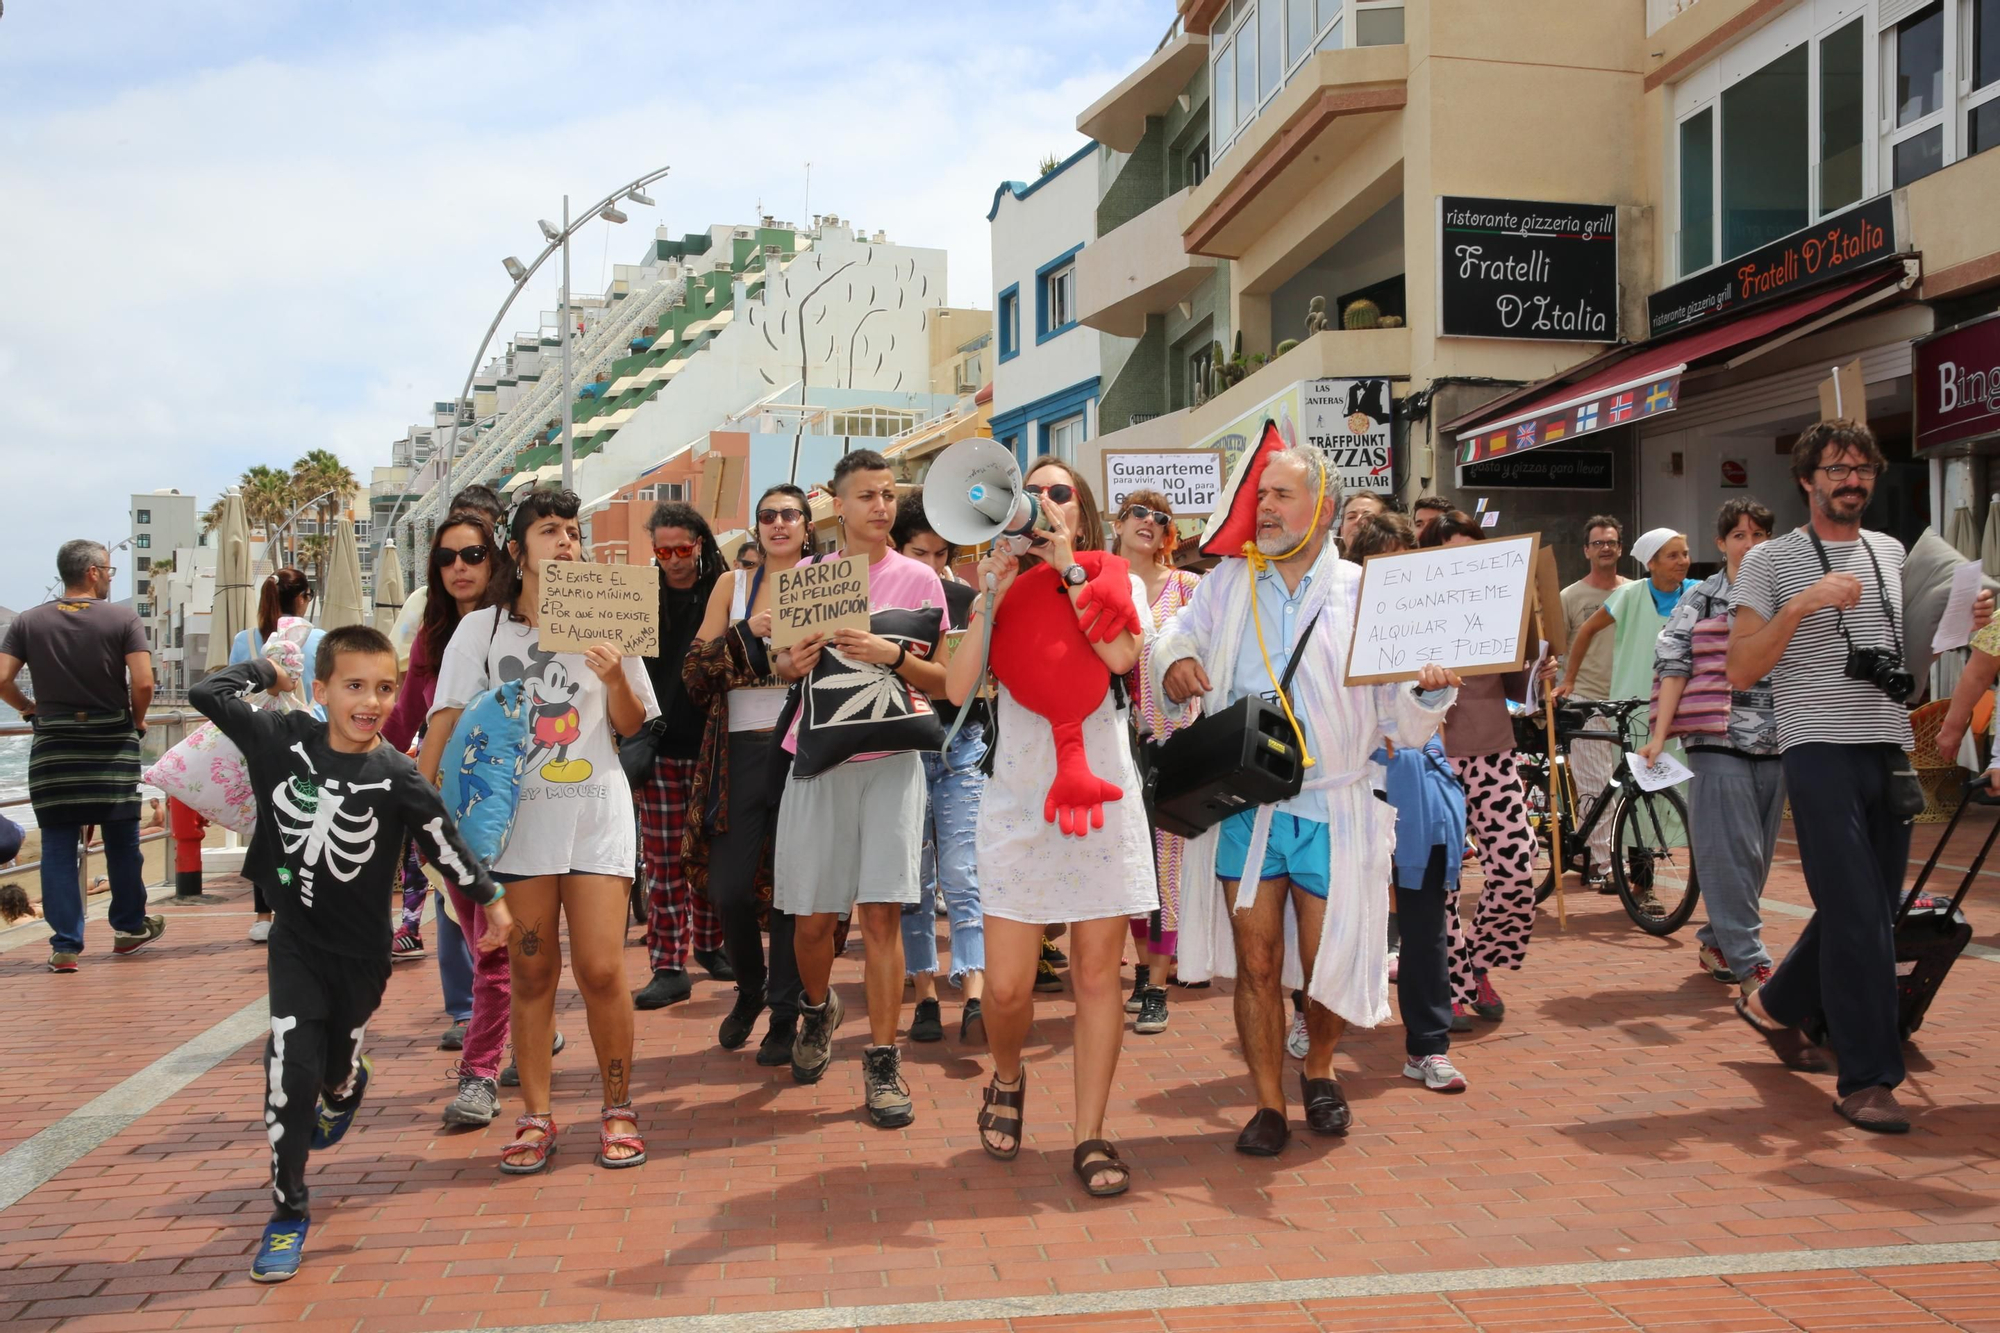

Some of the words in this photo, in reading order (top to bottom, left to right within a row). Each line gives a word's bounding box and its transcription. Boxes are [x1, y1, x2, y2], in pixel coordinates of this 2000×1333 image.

[1446, 209, 1518, 229] ristorante
[1519, 213, 1580, 238] pizzeria
[1582, 212, 1613, 241] grill
[1455, 244, 1551, 283] Fratelli
[1652, 306, 1686, 327] ristorante
[1686, 294, 1716, 322] pizzeria
[1716, 282, 1732, 311] grill
[1738, 248, 1799, 299] Fratelli
[1315, 384, 1331, 393] LAS
[1308, 433, 1386, 449] TRÄFFPUNKT
[1322, 447, 1387, 468] ZZAS
[1112, 462, 1214, 476] Guanarteme
[1470, 461, 1500, 478] pasta
[1501, 464, 1511, 479] y
[1511, 460, 1547, 479] pizzas
[1548, 464, 1574, 480] para
[1576, 459, 1605, 475] llevar
[1113, 476, 1133, 485] para
[1135, 475, 1156, 486] vivir,
[1162, 477, 1185, 490] NO
[1195, 482, 1215, 491] para
[610, 571, 627, 586] EL
[779, 560, 852, 594] BARRIO
[1382, 568, 1412, 586] EN
[1425, 564, 1444, 582] LA
[1450, 550, 1525, 577] ISLETA
[546, 586, 594, 600] SALARIO
[779, 591, 799, 606] EN
[802, 580, 861, 600] PELIGRO
[1376, 601, 1387, 615] O
[1395, 584, 1513, 612] GUANARTEME
[598, 610, 613, 619] NO
[779, 606, 794, 620] DE
[791, 593, 868, 628] EXTINCIÓN
[550, 622, 566, 635] EL
[1463, 612, 1484, 634] YA
[1377, 643, 1406, 671] NO
[1415, 647, 1444, 662] SE
[1450, 637, 1517, 661] PUEDE
[545, 783, 608, 800] MOUSE
